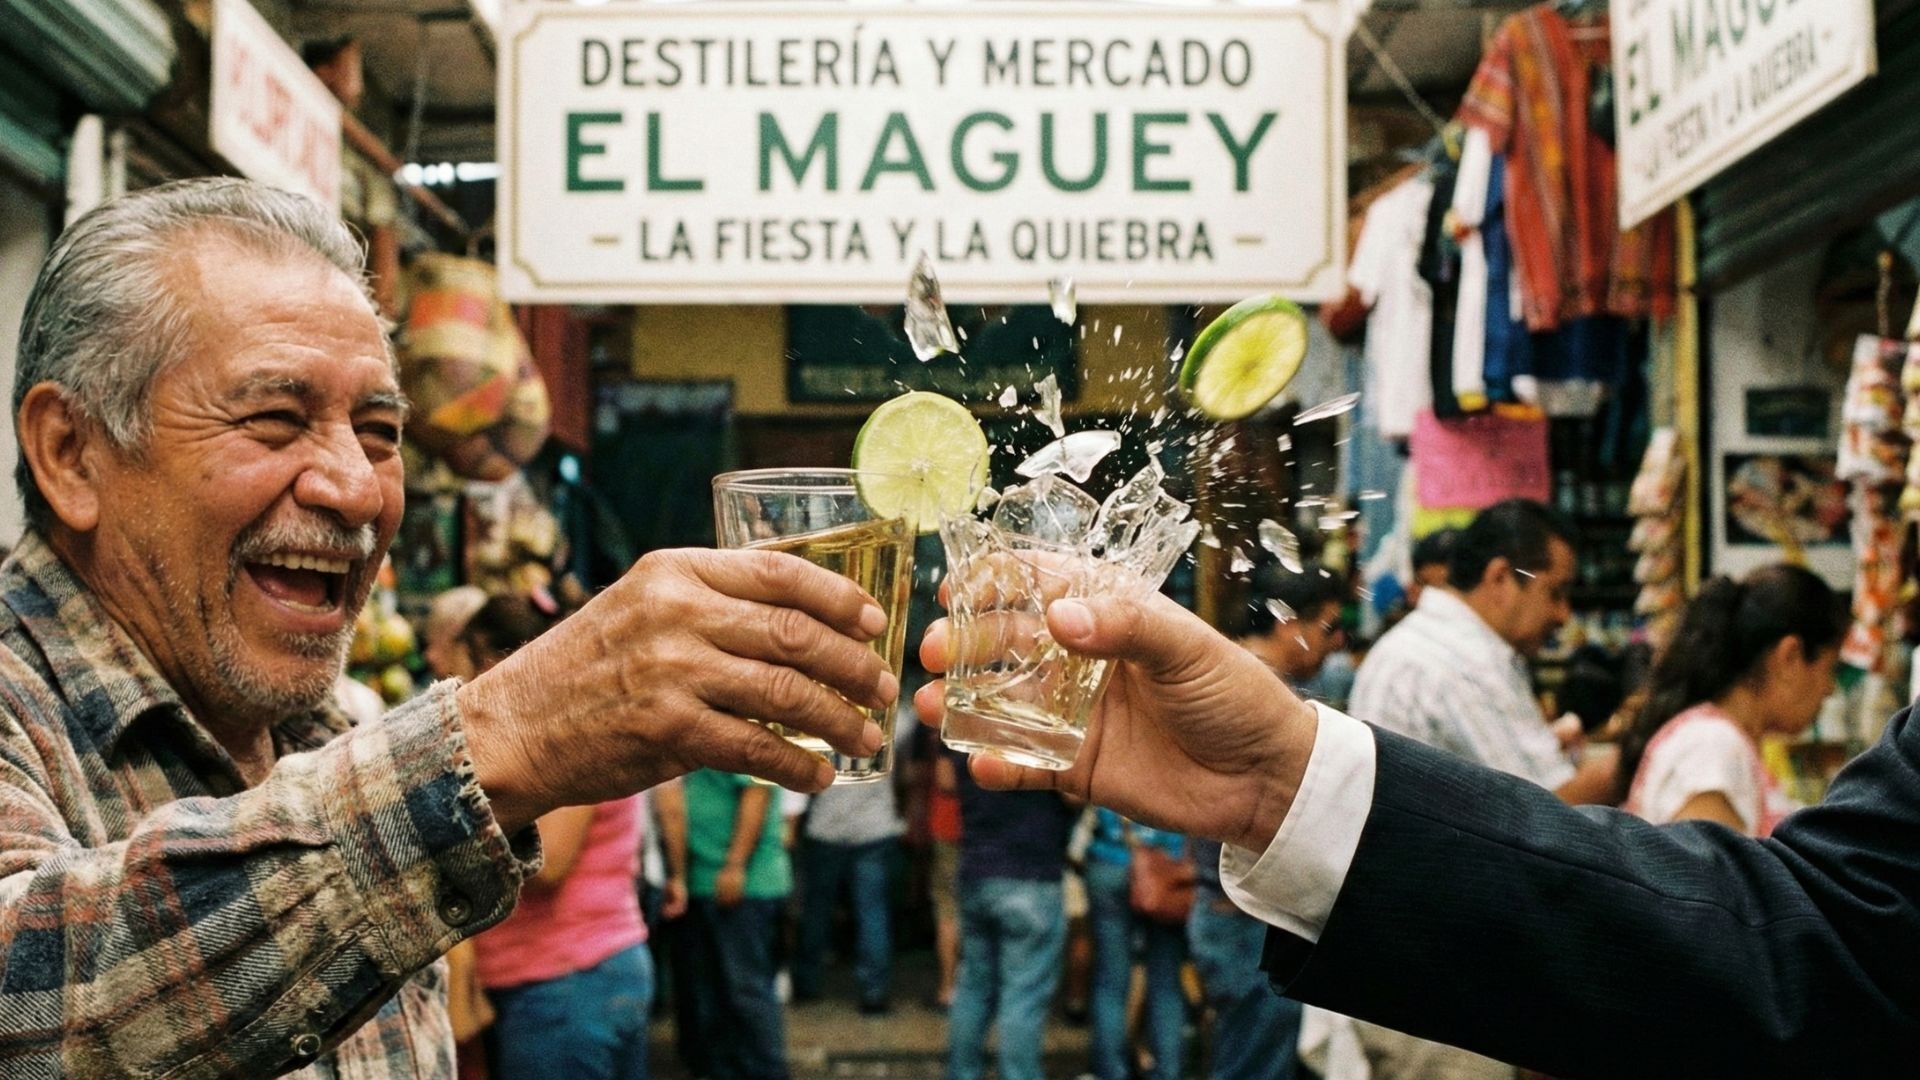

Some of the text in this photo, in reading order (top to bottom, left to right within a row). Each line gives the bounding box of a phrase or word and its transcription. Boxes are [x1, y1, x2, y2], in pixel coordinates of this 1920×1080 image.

[581, 25, 1254, 88] DESTILERÍA Y MERCADO
[564, 111, 1279, 194] EL MAGUEY
[640, 219, 1216, 262] LA FIESTA Y LA QUIEBRA
